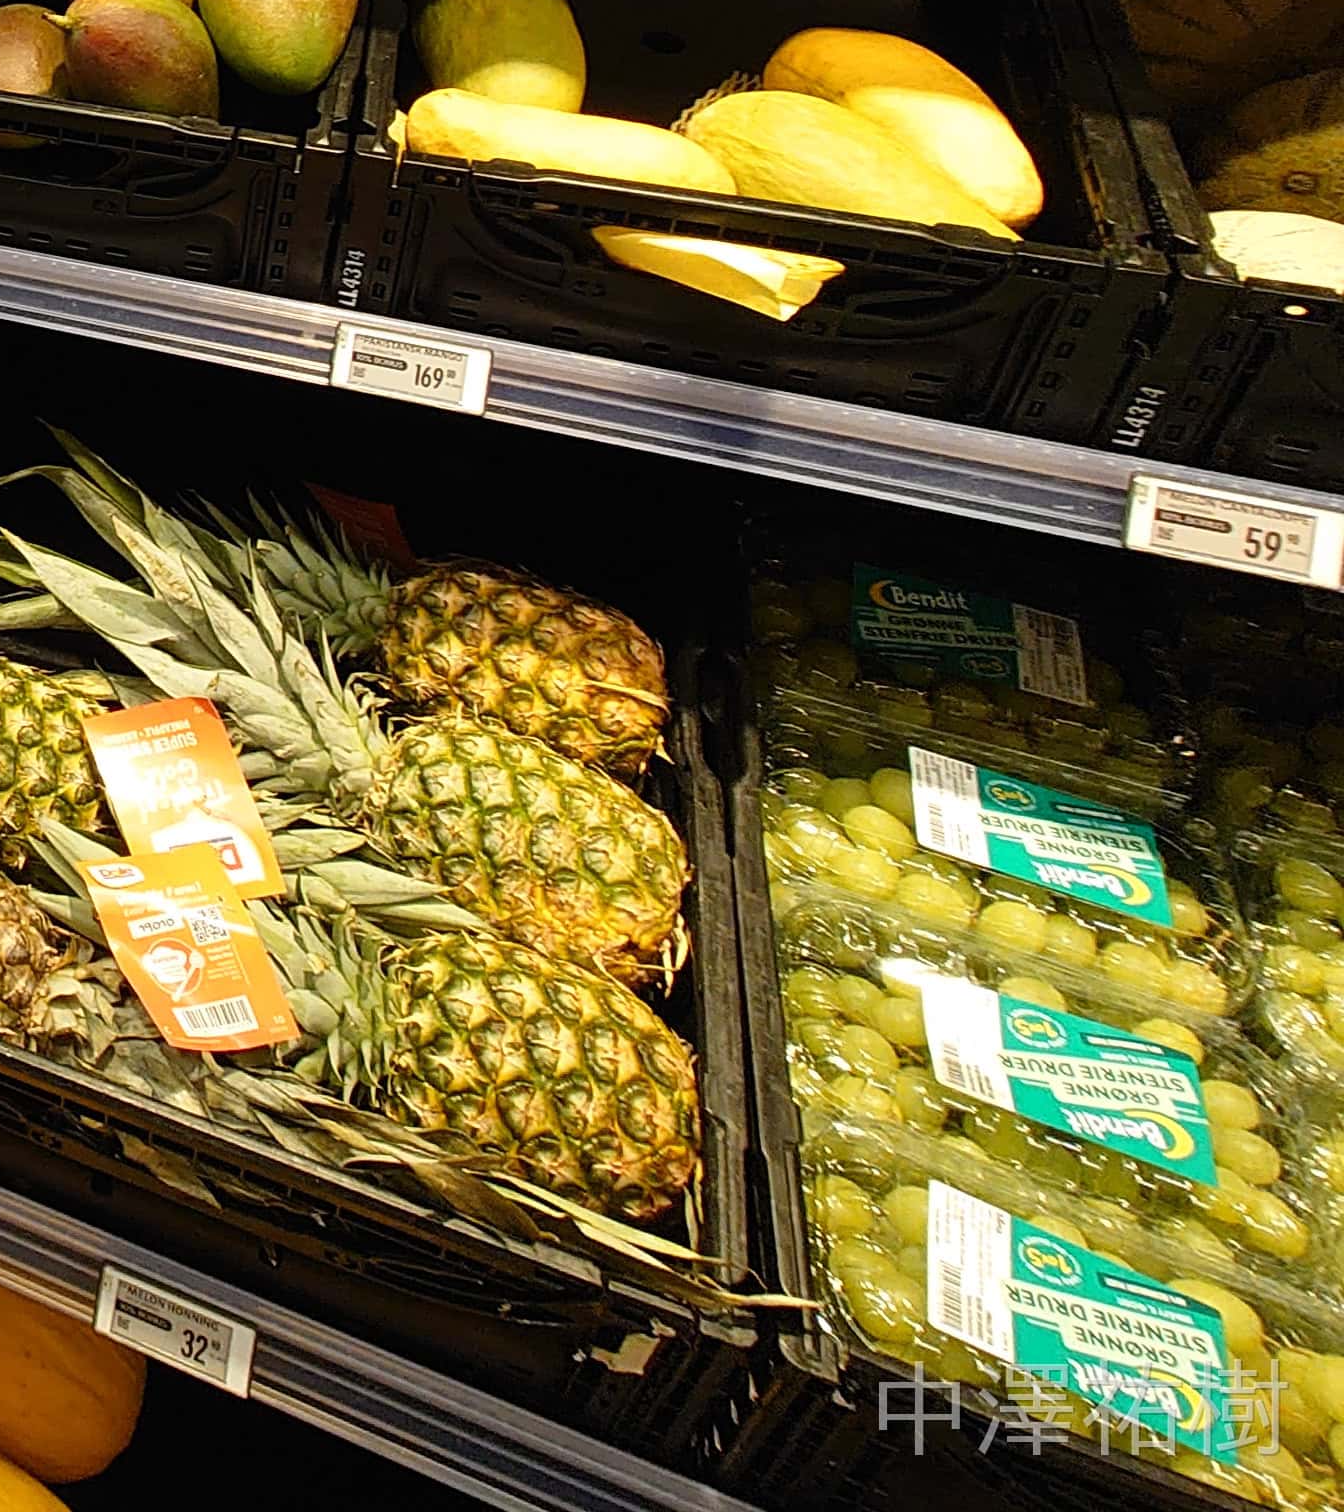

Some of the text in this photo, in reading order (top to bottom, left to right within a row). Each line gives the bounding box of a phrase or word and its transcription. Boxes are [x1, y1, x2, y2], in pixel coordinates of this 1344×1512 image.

[338, 250, 366, 308] LL4314
[414, 364, 444, 389] 169
[1112, 386, 1167, 447] LL4314
[1244, 526, 1282, 561] 59
[890, 585, 970, 610] Bendit
[864, 625, 1024, 649] STENFRIE DRUER
[888, 615, 967, 631] GRØNNE
[978, 813, 1045, 835] DRUER
[1049, 826, 1144, 853] STENFRIE
[1036, 838, 1120, 864] GRØNNE
[998, 1053, 1186, 1094] STENFRIE DRUER
[1063, 1082, 1160, 1107] GRØNNE
[1059, 1106, 1168, 1150] Bendit
[127, 1285, 219, 1332] MELON HONNING
[1005, 1283, 1085, 1323] DRUER
[181, 1329, 208, 1366] 32
[1076, 1326, 1179, 1367] GRØNNE
[1095, 1309, 1211, 1356] STENFRIE
